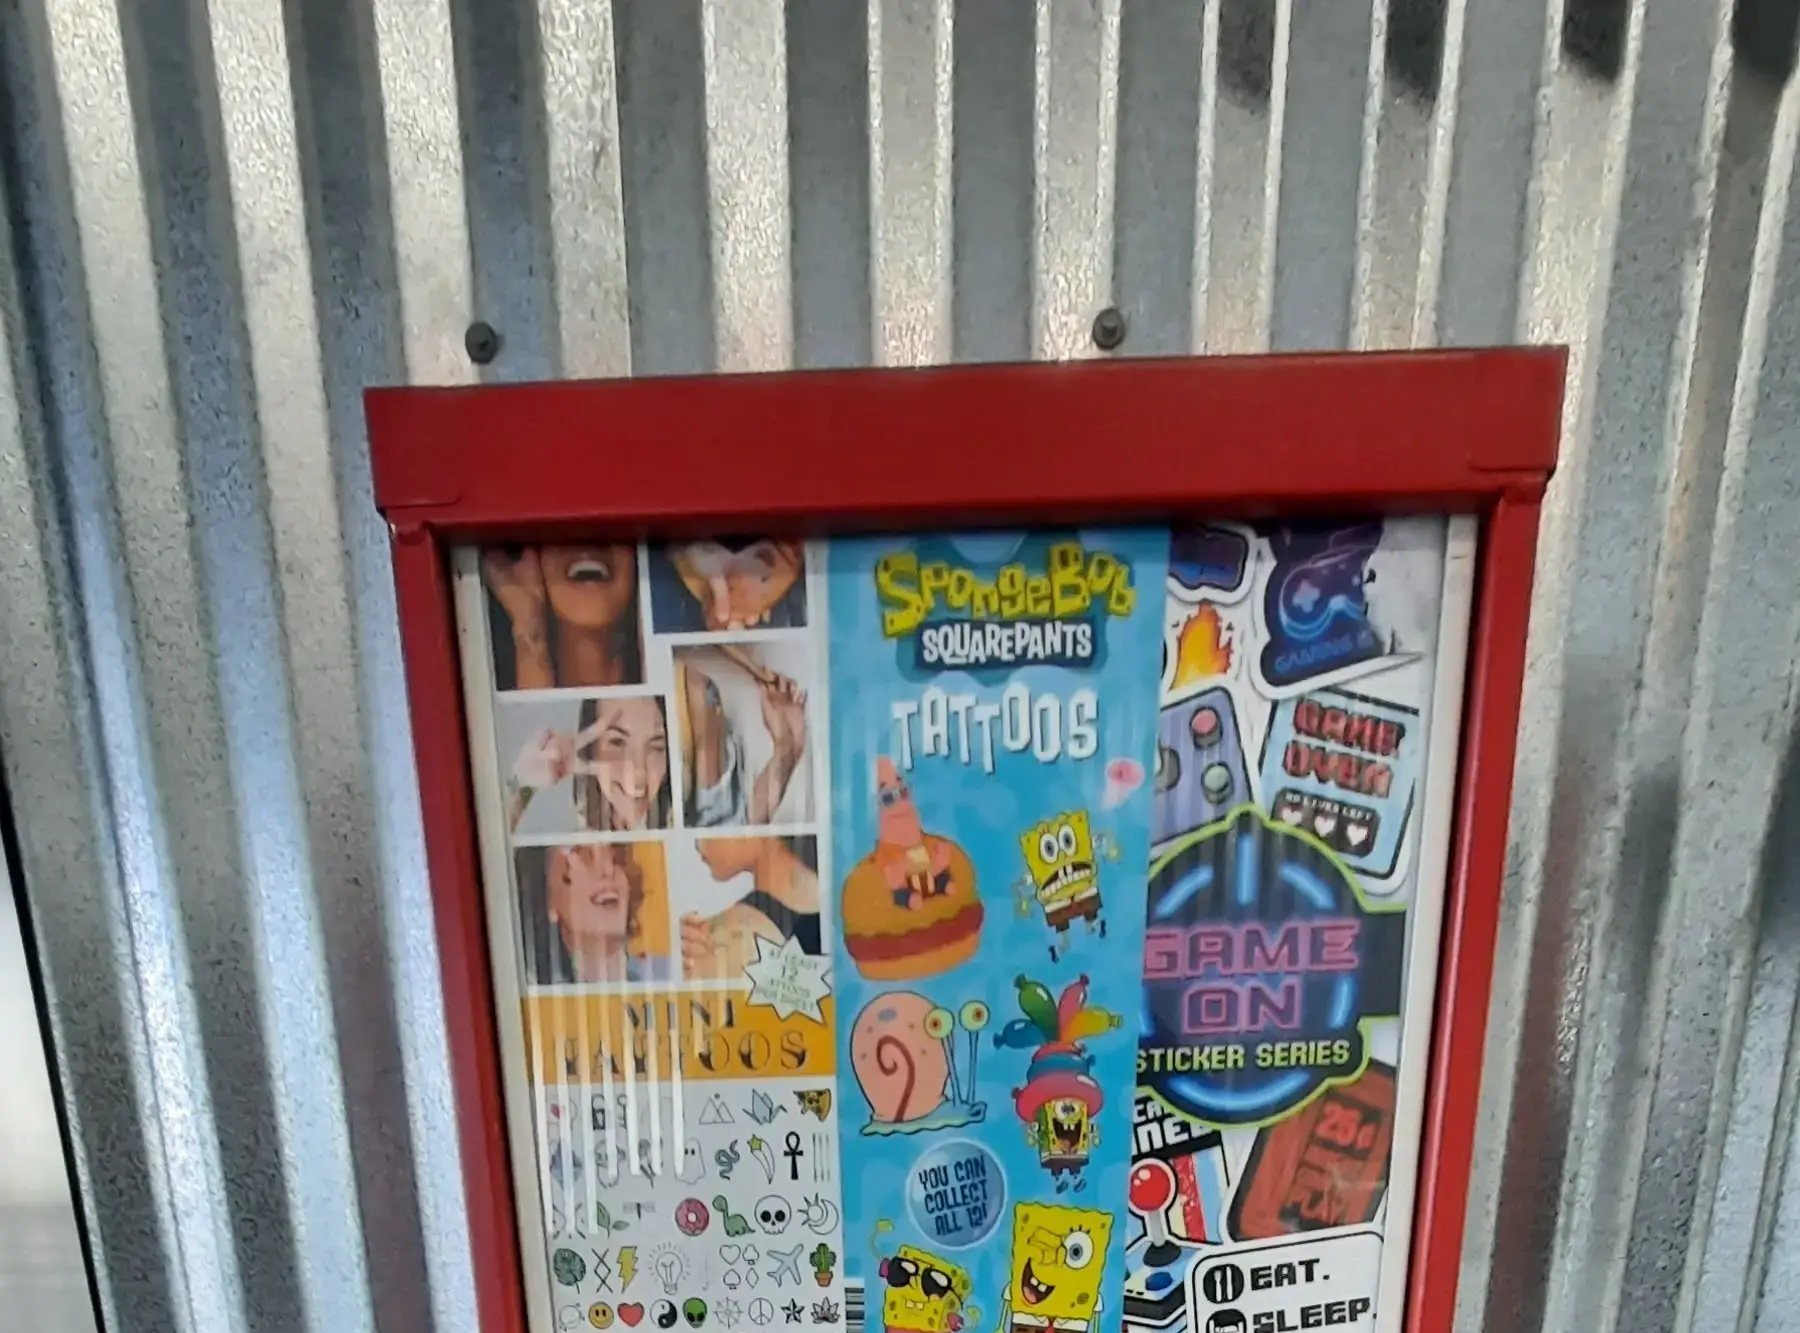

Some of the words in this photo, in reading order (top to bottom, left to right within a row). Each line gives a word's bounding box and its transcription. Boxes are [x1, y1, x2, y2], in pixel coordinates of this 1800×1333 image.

[922, 619, 1093, 665] SQUAREPANTS
[892, 681, 1099, 775] TATTOOS
[1293, 697, 1406, 758] GAME
[1282, 739, 1395, 799] OVER
[1143, 916, 1361, 980] GAME
[624, 997, 735, 1029] MINI
[1182, 978, 1301, 1036] ON
[1135, 1043, 1245, 1075] STICKER
[1255, 1039, 1350, 1067] SERIES
[919, 1165, 949, 1191] YOU
[954, 1155, 986, 1182] CAN
[924, 1179, 987, 1214] COLLECT
[935, 1211, 963, 1235] ALL
[966, 1202, 988, 1228] 12!
[1250, 1258, 1330, 1291] EAT.
